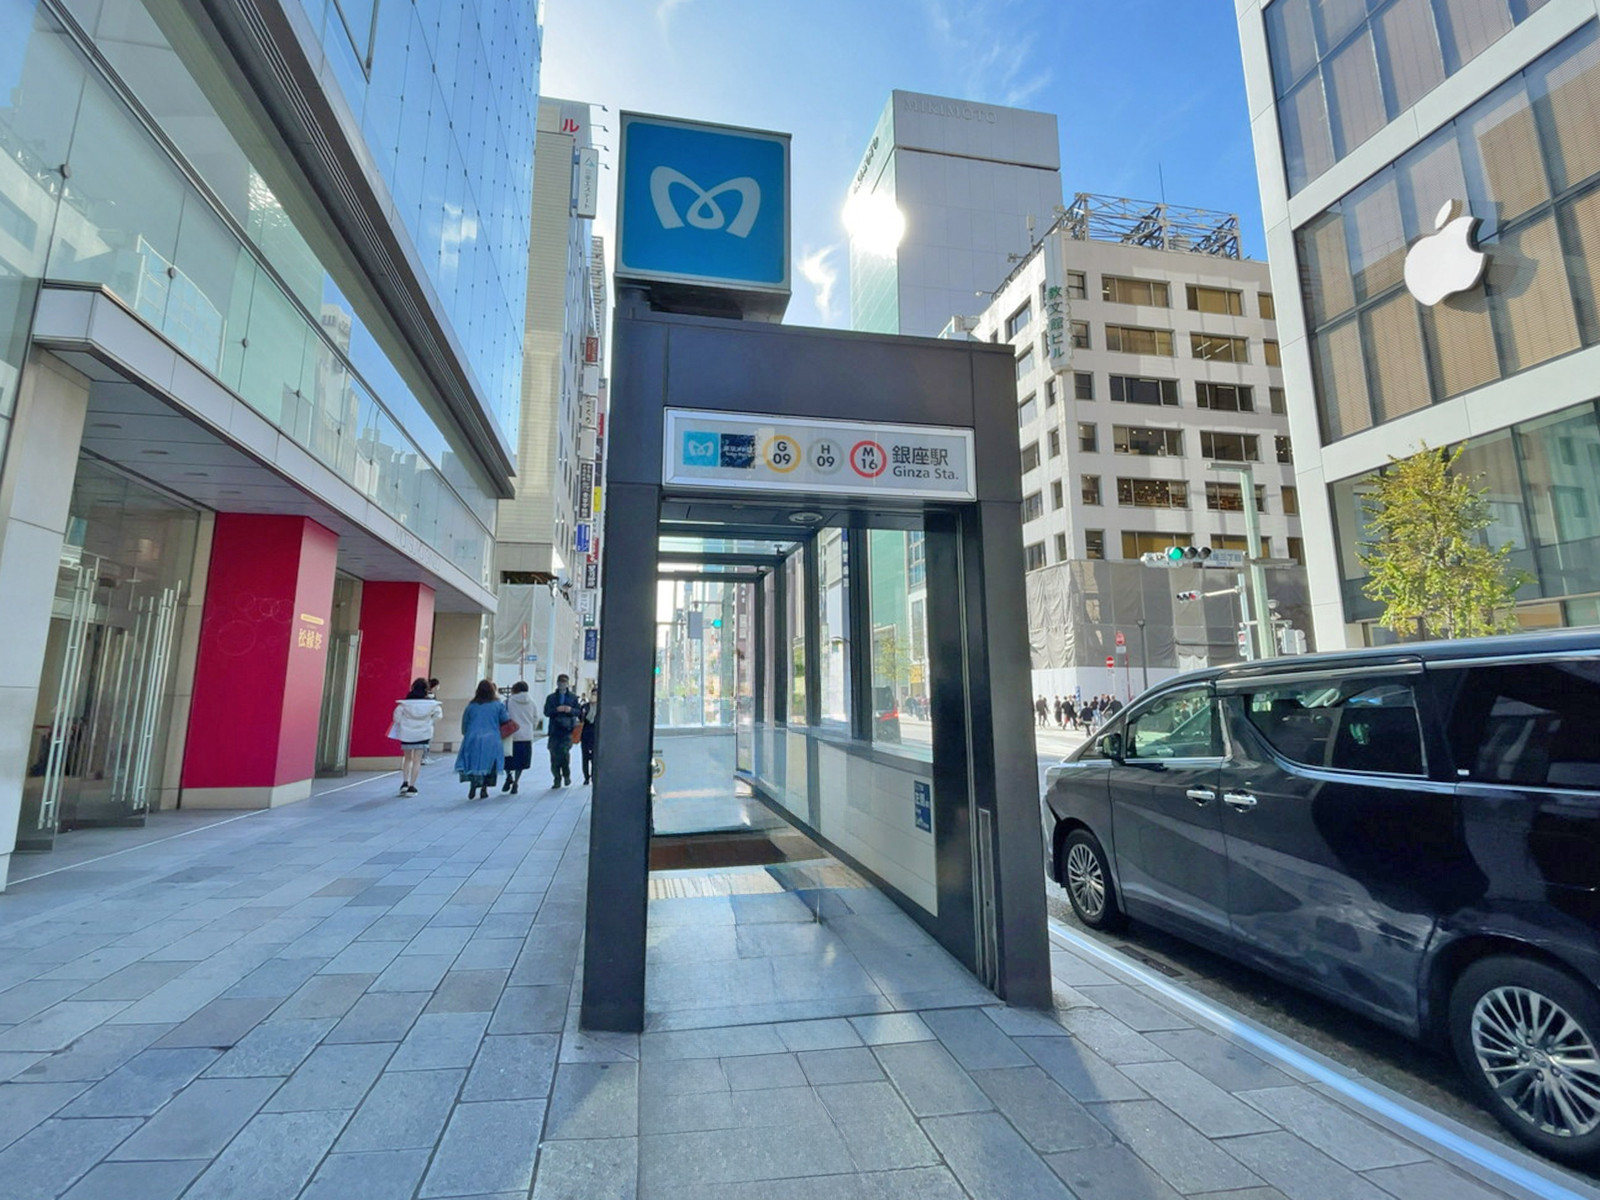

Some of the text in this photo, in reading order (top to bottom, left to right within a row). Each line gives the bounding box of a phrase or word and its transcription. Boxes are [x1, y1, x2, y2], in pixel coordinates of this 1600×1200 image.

[1047, 285, 1065, 359] 教文館ビル
[777, 441, 788, 452] G
[821, 444, 831, 455] H
[863, 447, 875, 457] M
[773, 453, 791, 465] 09
[817, 456, 835, 467] 09
[892, 445, 948, 466] 銀座駅
[861, 458, 878, 470] 16
[893, 466, 959, 480] Ginza Sta.
